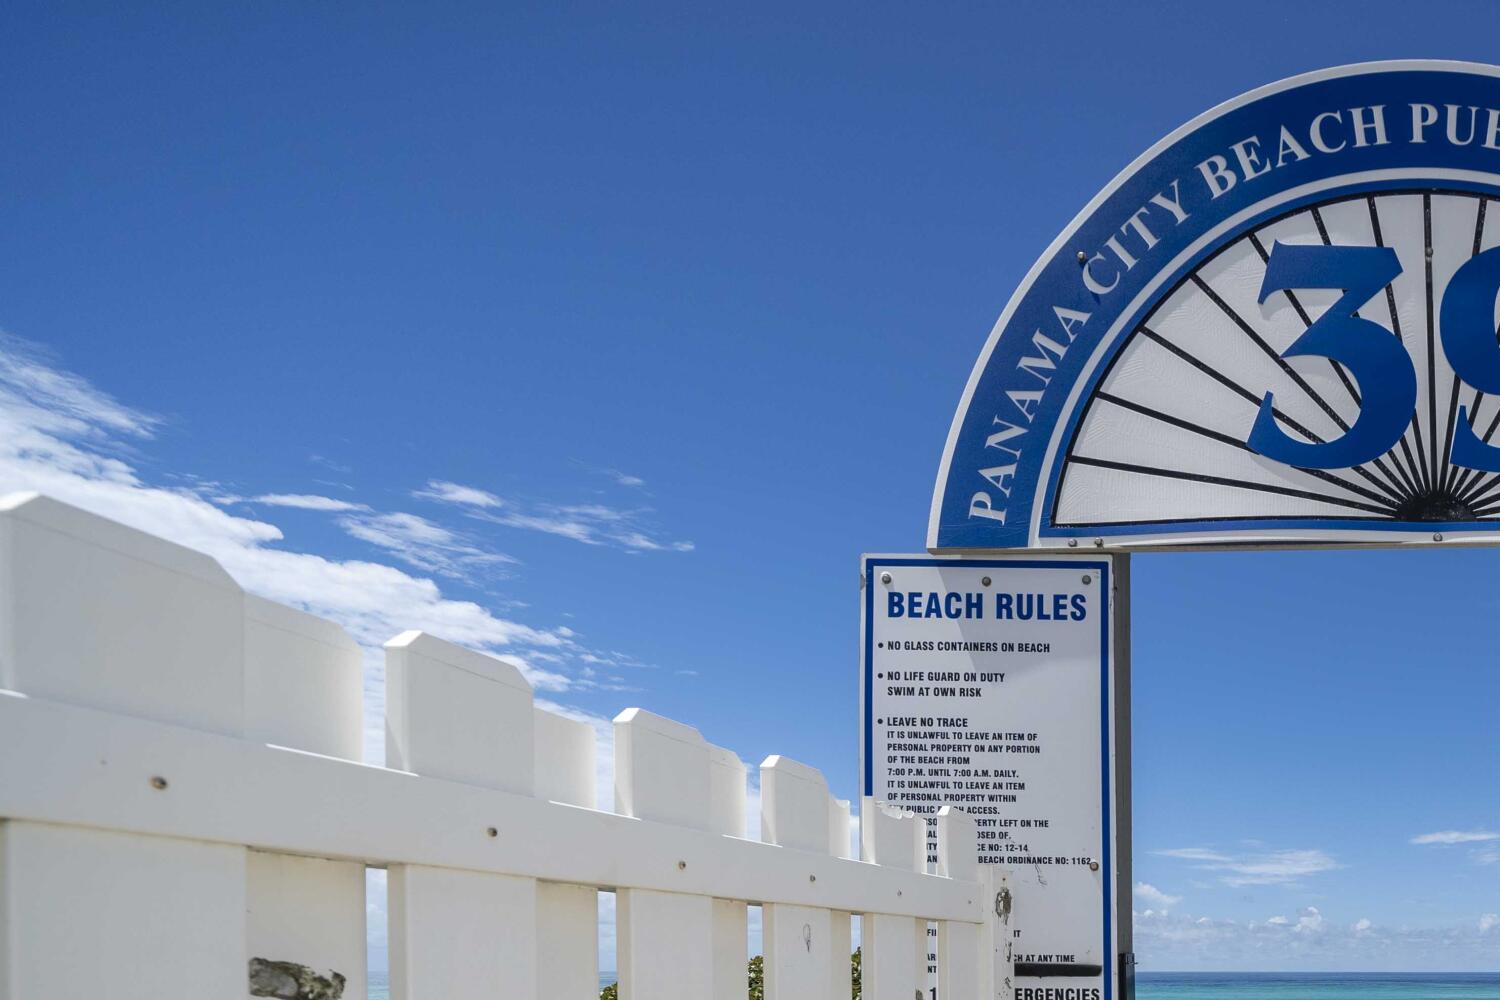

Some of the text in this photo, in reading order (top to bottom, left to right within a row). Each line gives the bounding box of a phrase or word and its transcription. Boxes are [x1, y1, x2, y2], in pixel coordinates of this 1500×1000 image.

[968, 304, 1091, 525] PANAMA
[1081, 180, 1191, 296] CITY
[1195, 103, 1391, 200] BEACH
[888, 592, 1086, 620] BEACH RULES
[888, 641, 1050, 652] NO GLASS CONTAINERS ON BEACH
[887, 672, 1005, 682] NO LIFE GUARD ON DUTY
[887, 687, 981, 697] SWIM AT OWN RISK
[887, 717, 968, 727] LEAVE NO TRACE
[897, 731, 905, 739] IS
[907, 731, 950, 739] UNLAWFUL
[952, 732, 963, 740] TO
[965, 732, 989, 740] LEAVE
[1005, 733, 1024, 741] ITEM
[1027, 733, 1037, 741] OF
[887, 743, 928, 751] PERSONAL
[931, 744, 972, 752] PROPERTY
[988, 745, 1003, 753] ANY
[1006, 745, 1040, 753] PORTION
[887, 755, 897, 763] OF
[900, 756, 915, 764] THE
[918, 756, 944, 764] BEACH
[887, 768, 1019, 778] 7:00 P.M. UNTIL 7:00 A.M. DAILY.
[887, 780, 895, 788] IT
[897, 780, 905, 788] IS
[908, 781, 950, 789] UNLAWFUL
[952, 781, 963, 789] TO
[992, 782, 1003, 790] AN
[1006, 782, 1025, 790] ITEM
[887, 792, 1016, 802] OF PERSONAL PROPERTY WITHIN
[906, 805, 935, 814] PUBLIC
[967, 806, 1000, 814] ACCESS.
[999, 819, 1048, 828] LEFT ON THE
[998, 831, 1011, 839] OF.
[1005, 844, 1028, 852] 12-14
[978, 856, 1092, 865] BEACH ORDINANCE NO: 1162
[1024, 954, 1035, 963] AT
[1037, 954, 1053, 962] ANY
